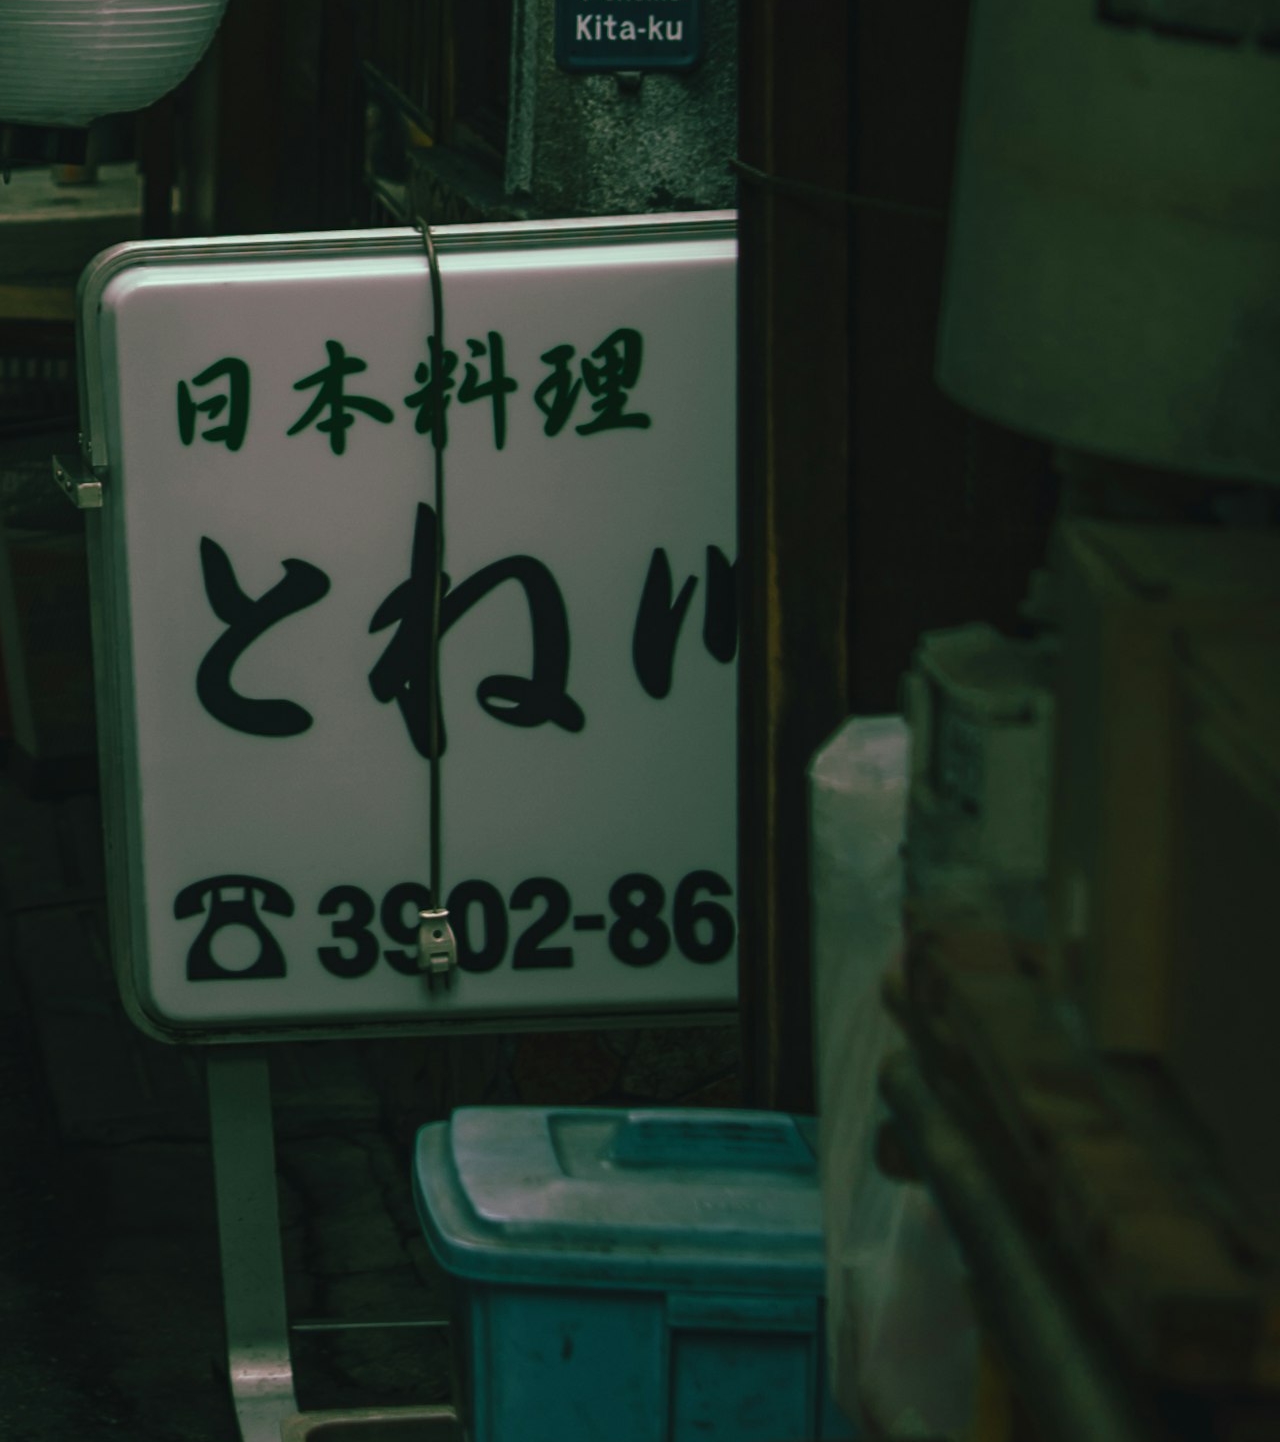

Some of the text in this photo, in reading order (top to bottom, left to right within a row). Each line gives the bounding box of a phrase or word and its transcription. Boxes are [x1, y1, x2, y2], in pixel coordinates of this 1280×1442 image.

[575, 13, 684, 42] Kita-ku
[177, 327, 652, 456] 日本料理
